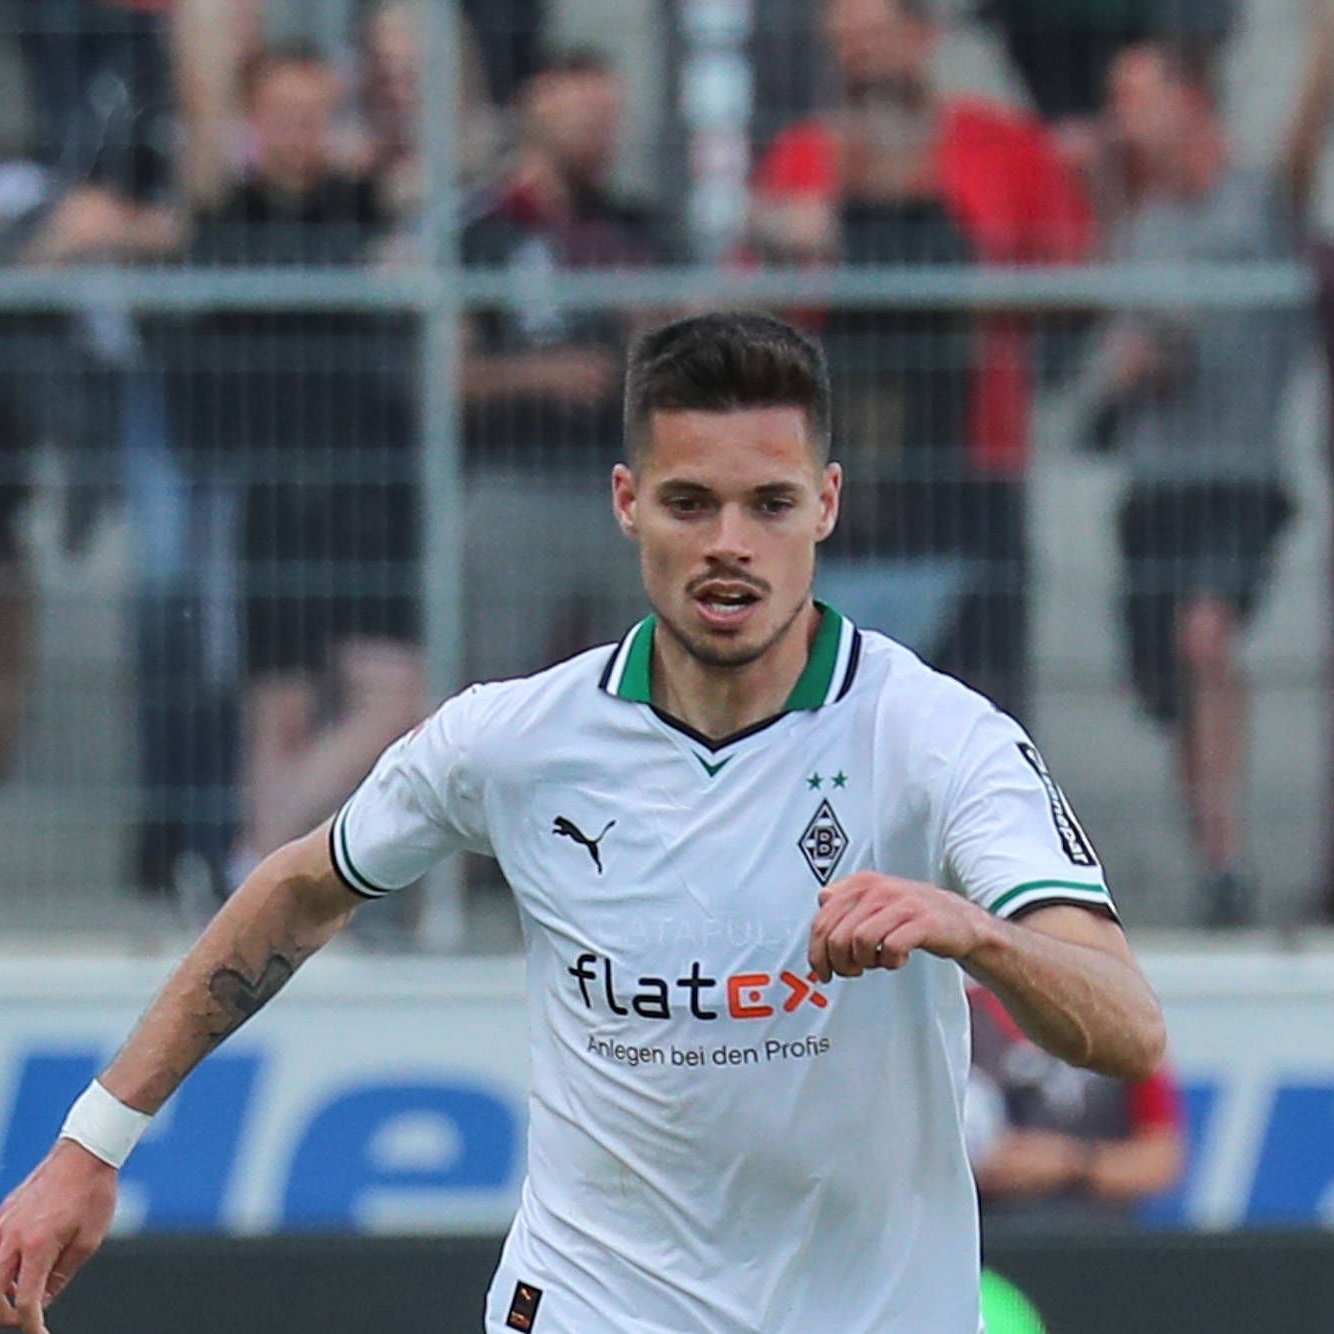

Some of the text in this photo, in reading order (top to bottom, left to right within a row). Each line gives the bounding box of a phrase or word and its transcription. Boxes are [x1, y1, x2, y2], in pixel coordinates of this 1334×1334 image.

[568, 954, 829, 1020] flatex
[587, 1035, 831, 1066] Anlegen bei den Profis
